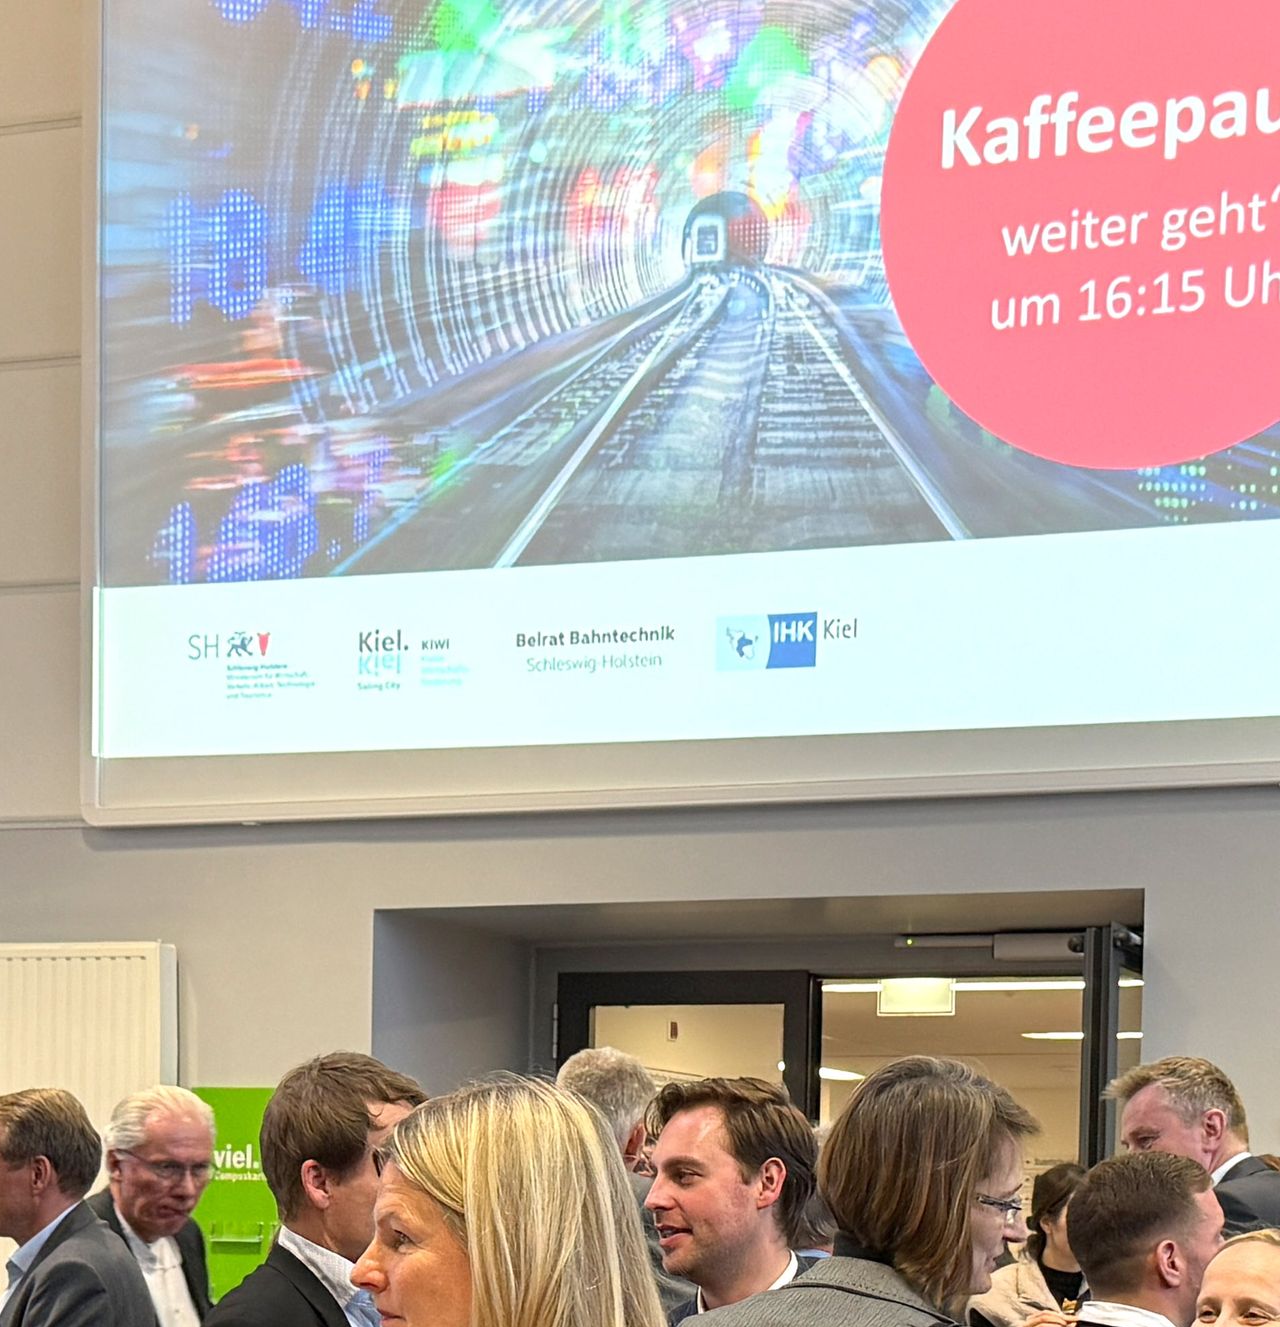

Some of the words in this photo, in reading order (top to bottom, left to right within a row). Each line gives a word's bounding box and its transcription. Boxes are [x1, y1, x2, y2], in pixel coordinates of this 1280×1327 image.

[1001, 208, 1148, 257] weiter
[990, 290, 1061, 330] um
[1078, 269, 1206, 321] 16:15
[570, 626, 675, 645] Bahntechnik
[773, 620, 814, 643] IHK
[823, 618, 858, 640] Kiel
[188, 634, 219, 660] SH
